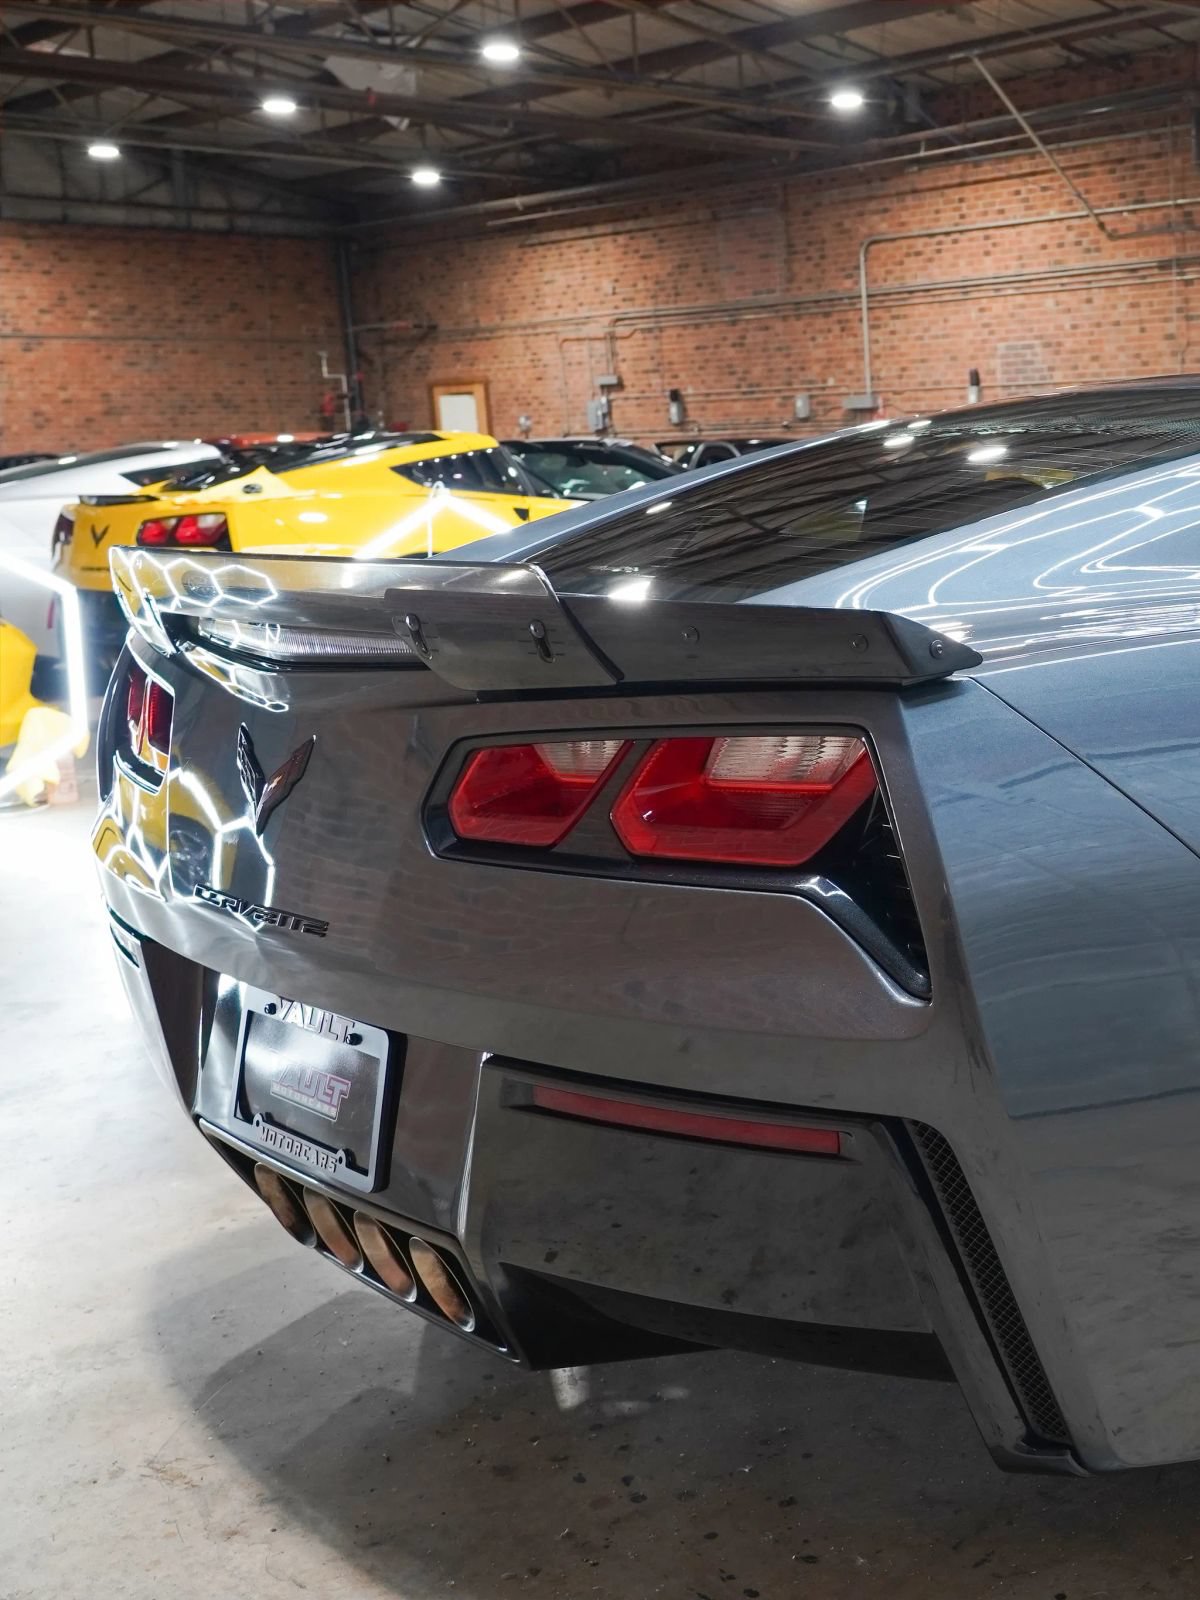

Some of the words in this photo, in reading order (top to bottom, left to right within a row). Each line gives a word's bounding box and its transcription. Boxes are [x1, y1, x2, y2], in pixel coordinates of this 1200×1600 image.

[193, 883, 329, 937] CORVETTE
[279, 997, 356, 1044] VAULT
[275, 1062, 351, 1107] AULT
[259, 1125, 338, 1173] MOTORCARS
